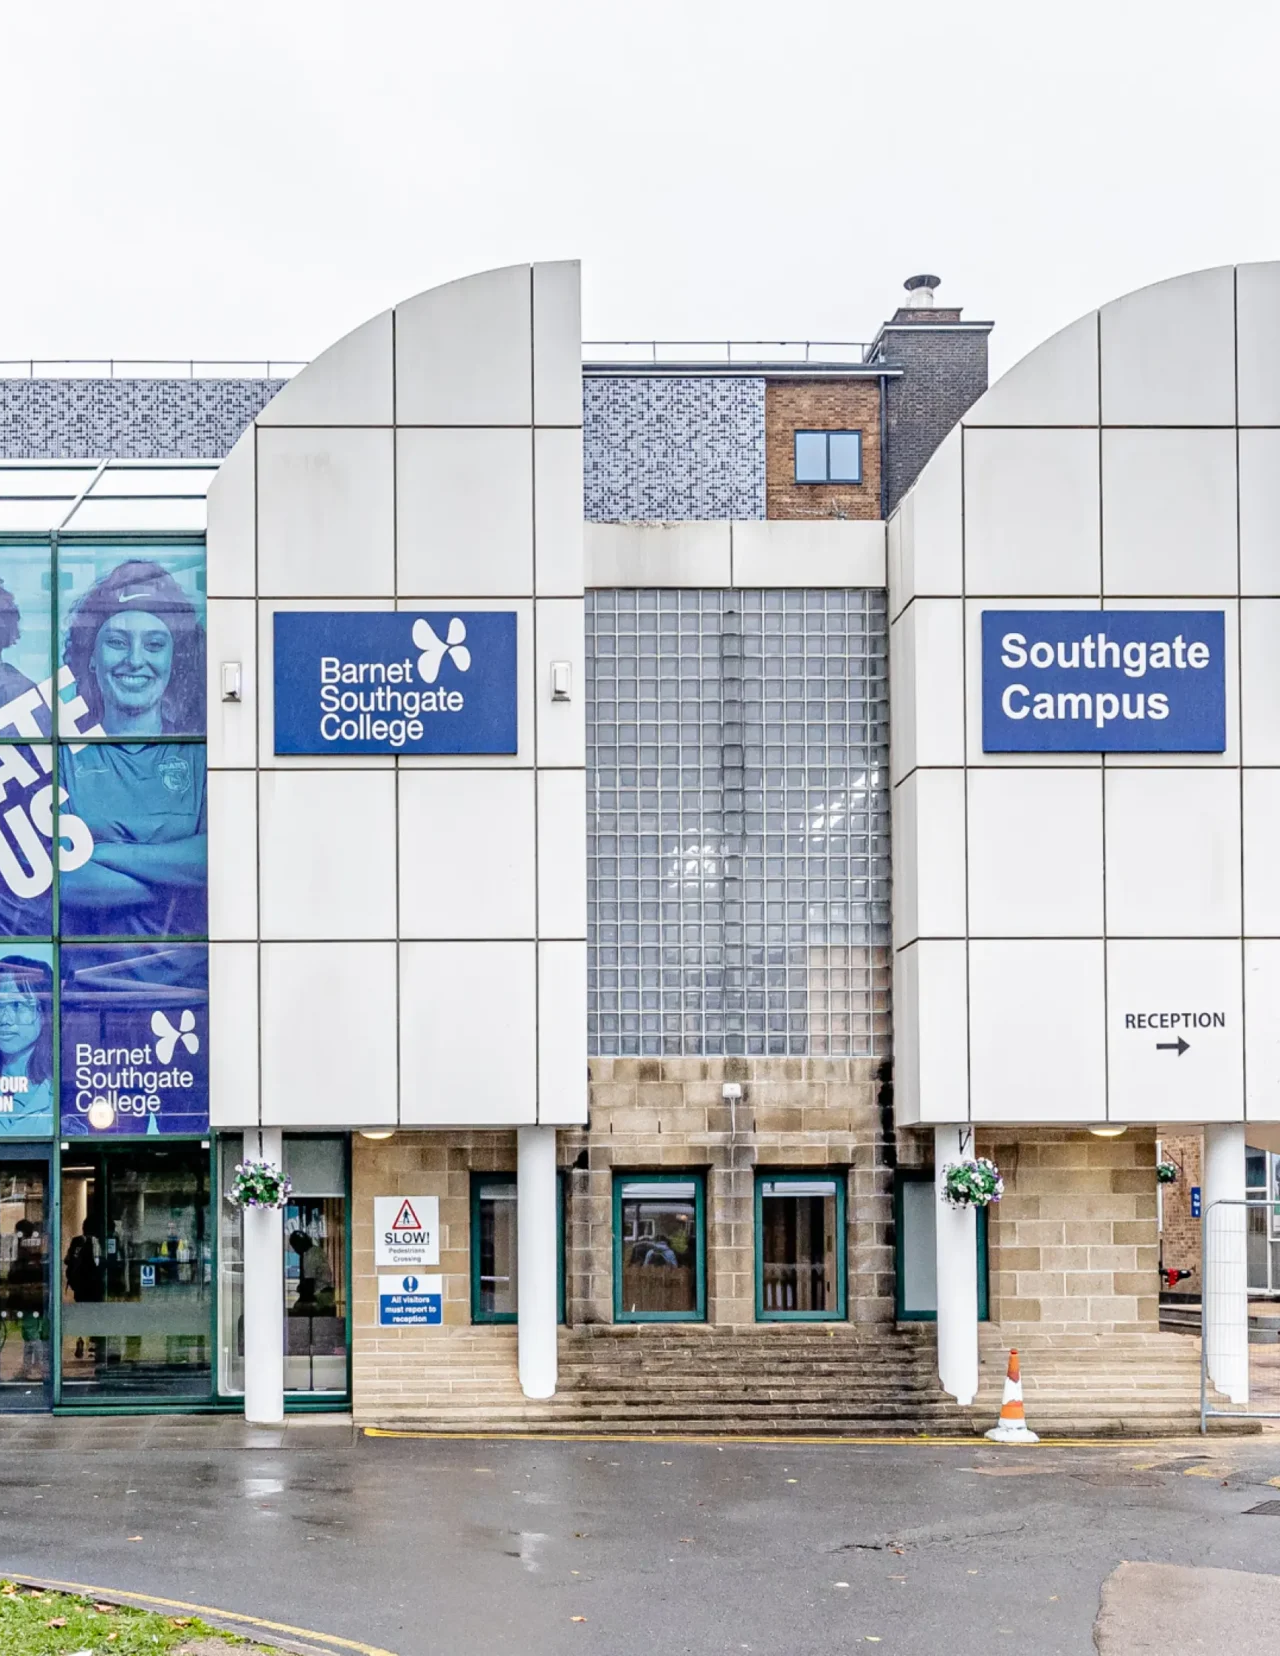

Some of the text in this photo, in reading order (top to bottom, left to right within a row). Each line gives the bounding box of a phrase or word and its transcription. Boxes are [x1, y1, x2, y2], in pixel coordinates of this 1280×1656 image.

[1001, 632, 1211, 678] Southgate
[320, 657, 413, 684] Barnet
[320, 685, 464, 718] Southgate
[1001, 683, 1170, 728] Campus
[320, 713, 424, 747] College
[1125, 1012, 1225, 1029] RECEPTION
[75, 1043, 152, 1066] Barnet
[75, 1066, 194, 1094] Southgate
[384, 1231, 430, 1245] SLOW!
[391, 1296, 430, 1304] All visitors
[405, 1306, 427, 1314] report
[392, 1315, 427, 1323] reception
